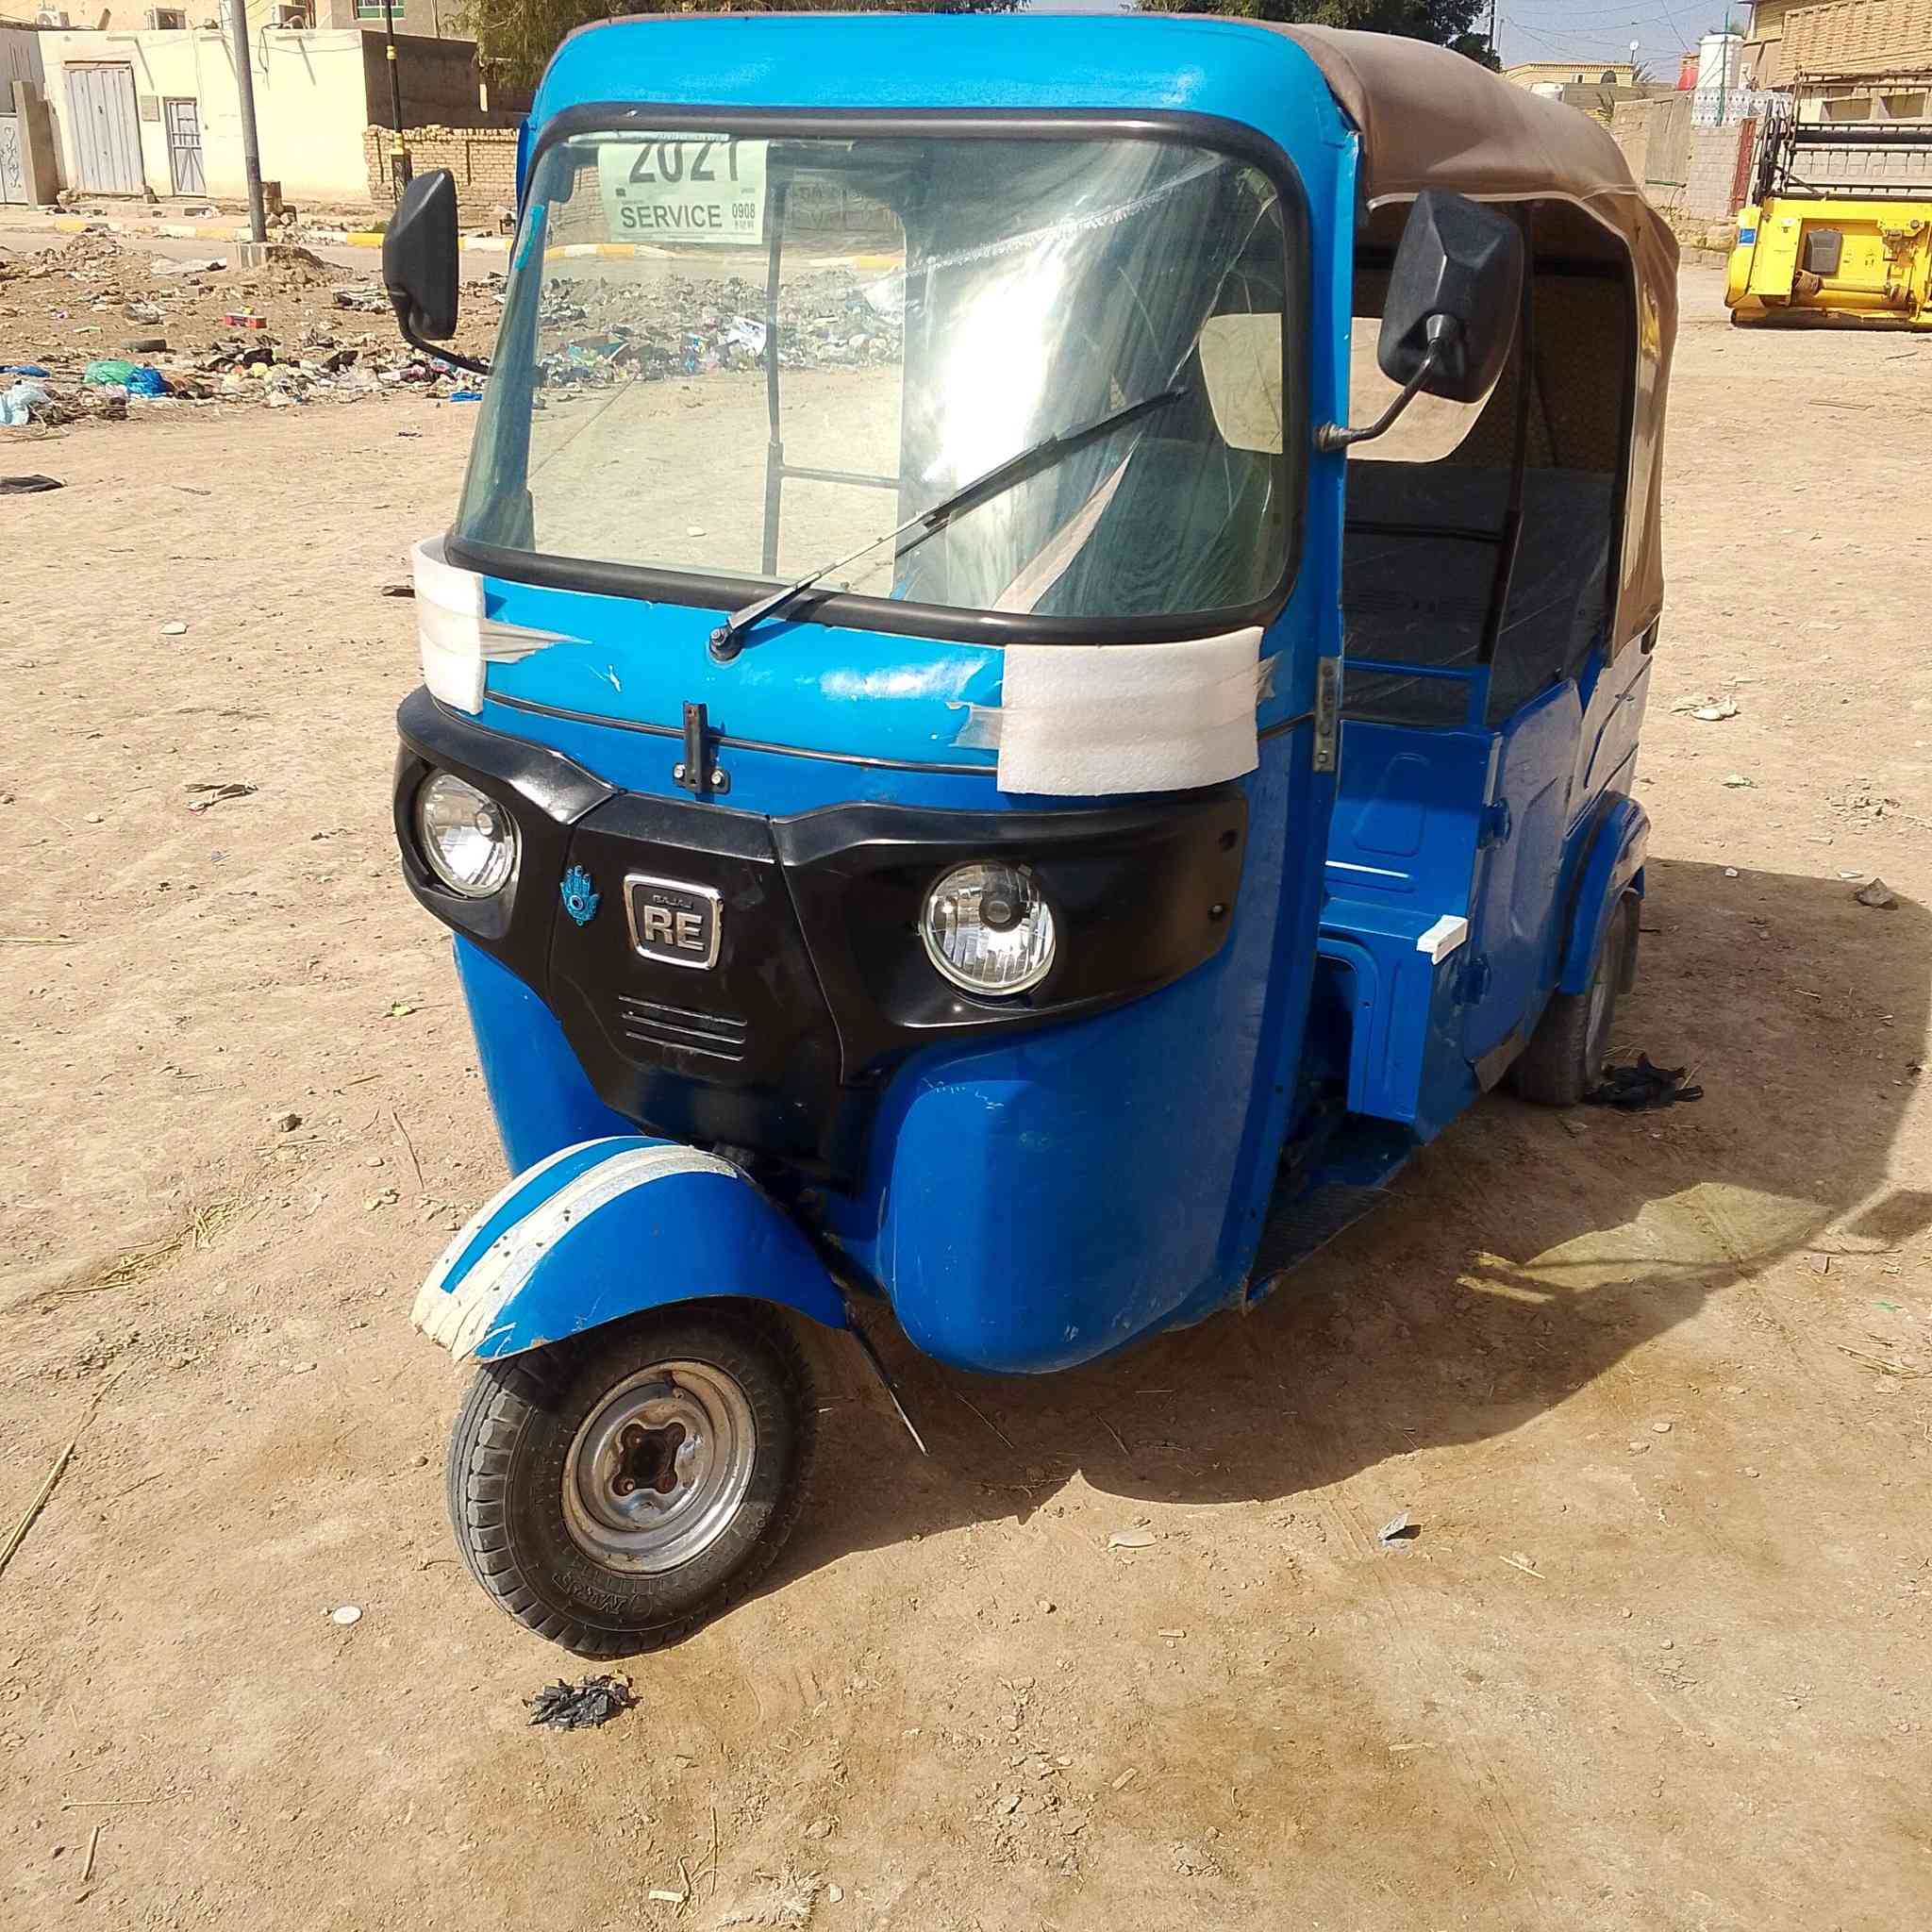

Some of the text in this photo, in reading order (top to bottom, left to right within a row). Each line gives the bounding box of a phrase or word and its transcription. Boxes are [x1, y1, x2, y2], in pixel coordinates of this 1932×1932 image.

[621, 205, 723, 228] SERVICE
[732, 203, 756, 220] 0908
[644, 906, 705, 951] RE
